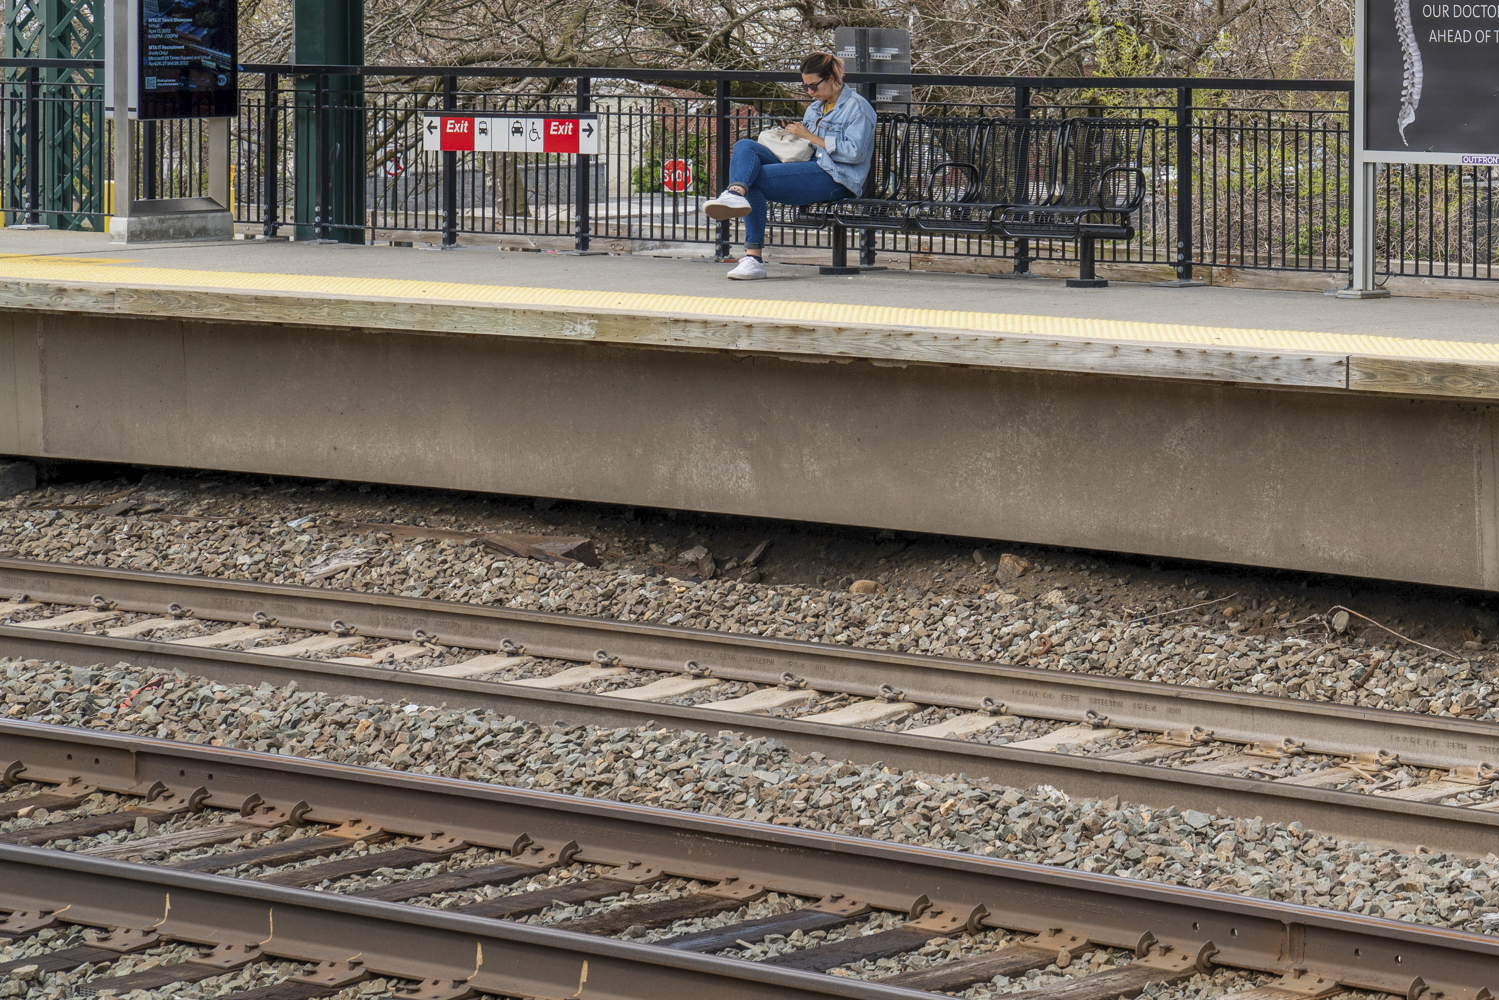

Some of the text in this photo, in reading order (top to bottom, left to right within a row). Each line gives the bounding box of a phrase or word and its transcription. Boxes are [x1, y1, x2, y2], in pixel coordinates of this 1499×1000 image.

[1422, 4, 1449, 18] OUR
[1428, 30, 1472, 43] AHEAD
[1475, 30, 1491, 43] OF
[446, 120, 469, 134] Exit
[550, 122, 573, 136] Exit
[664, 170, 689, 182] STOP
